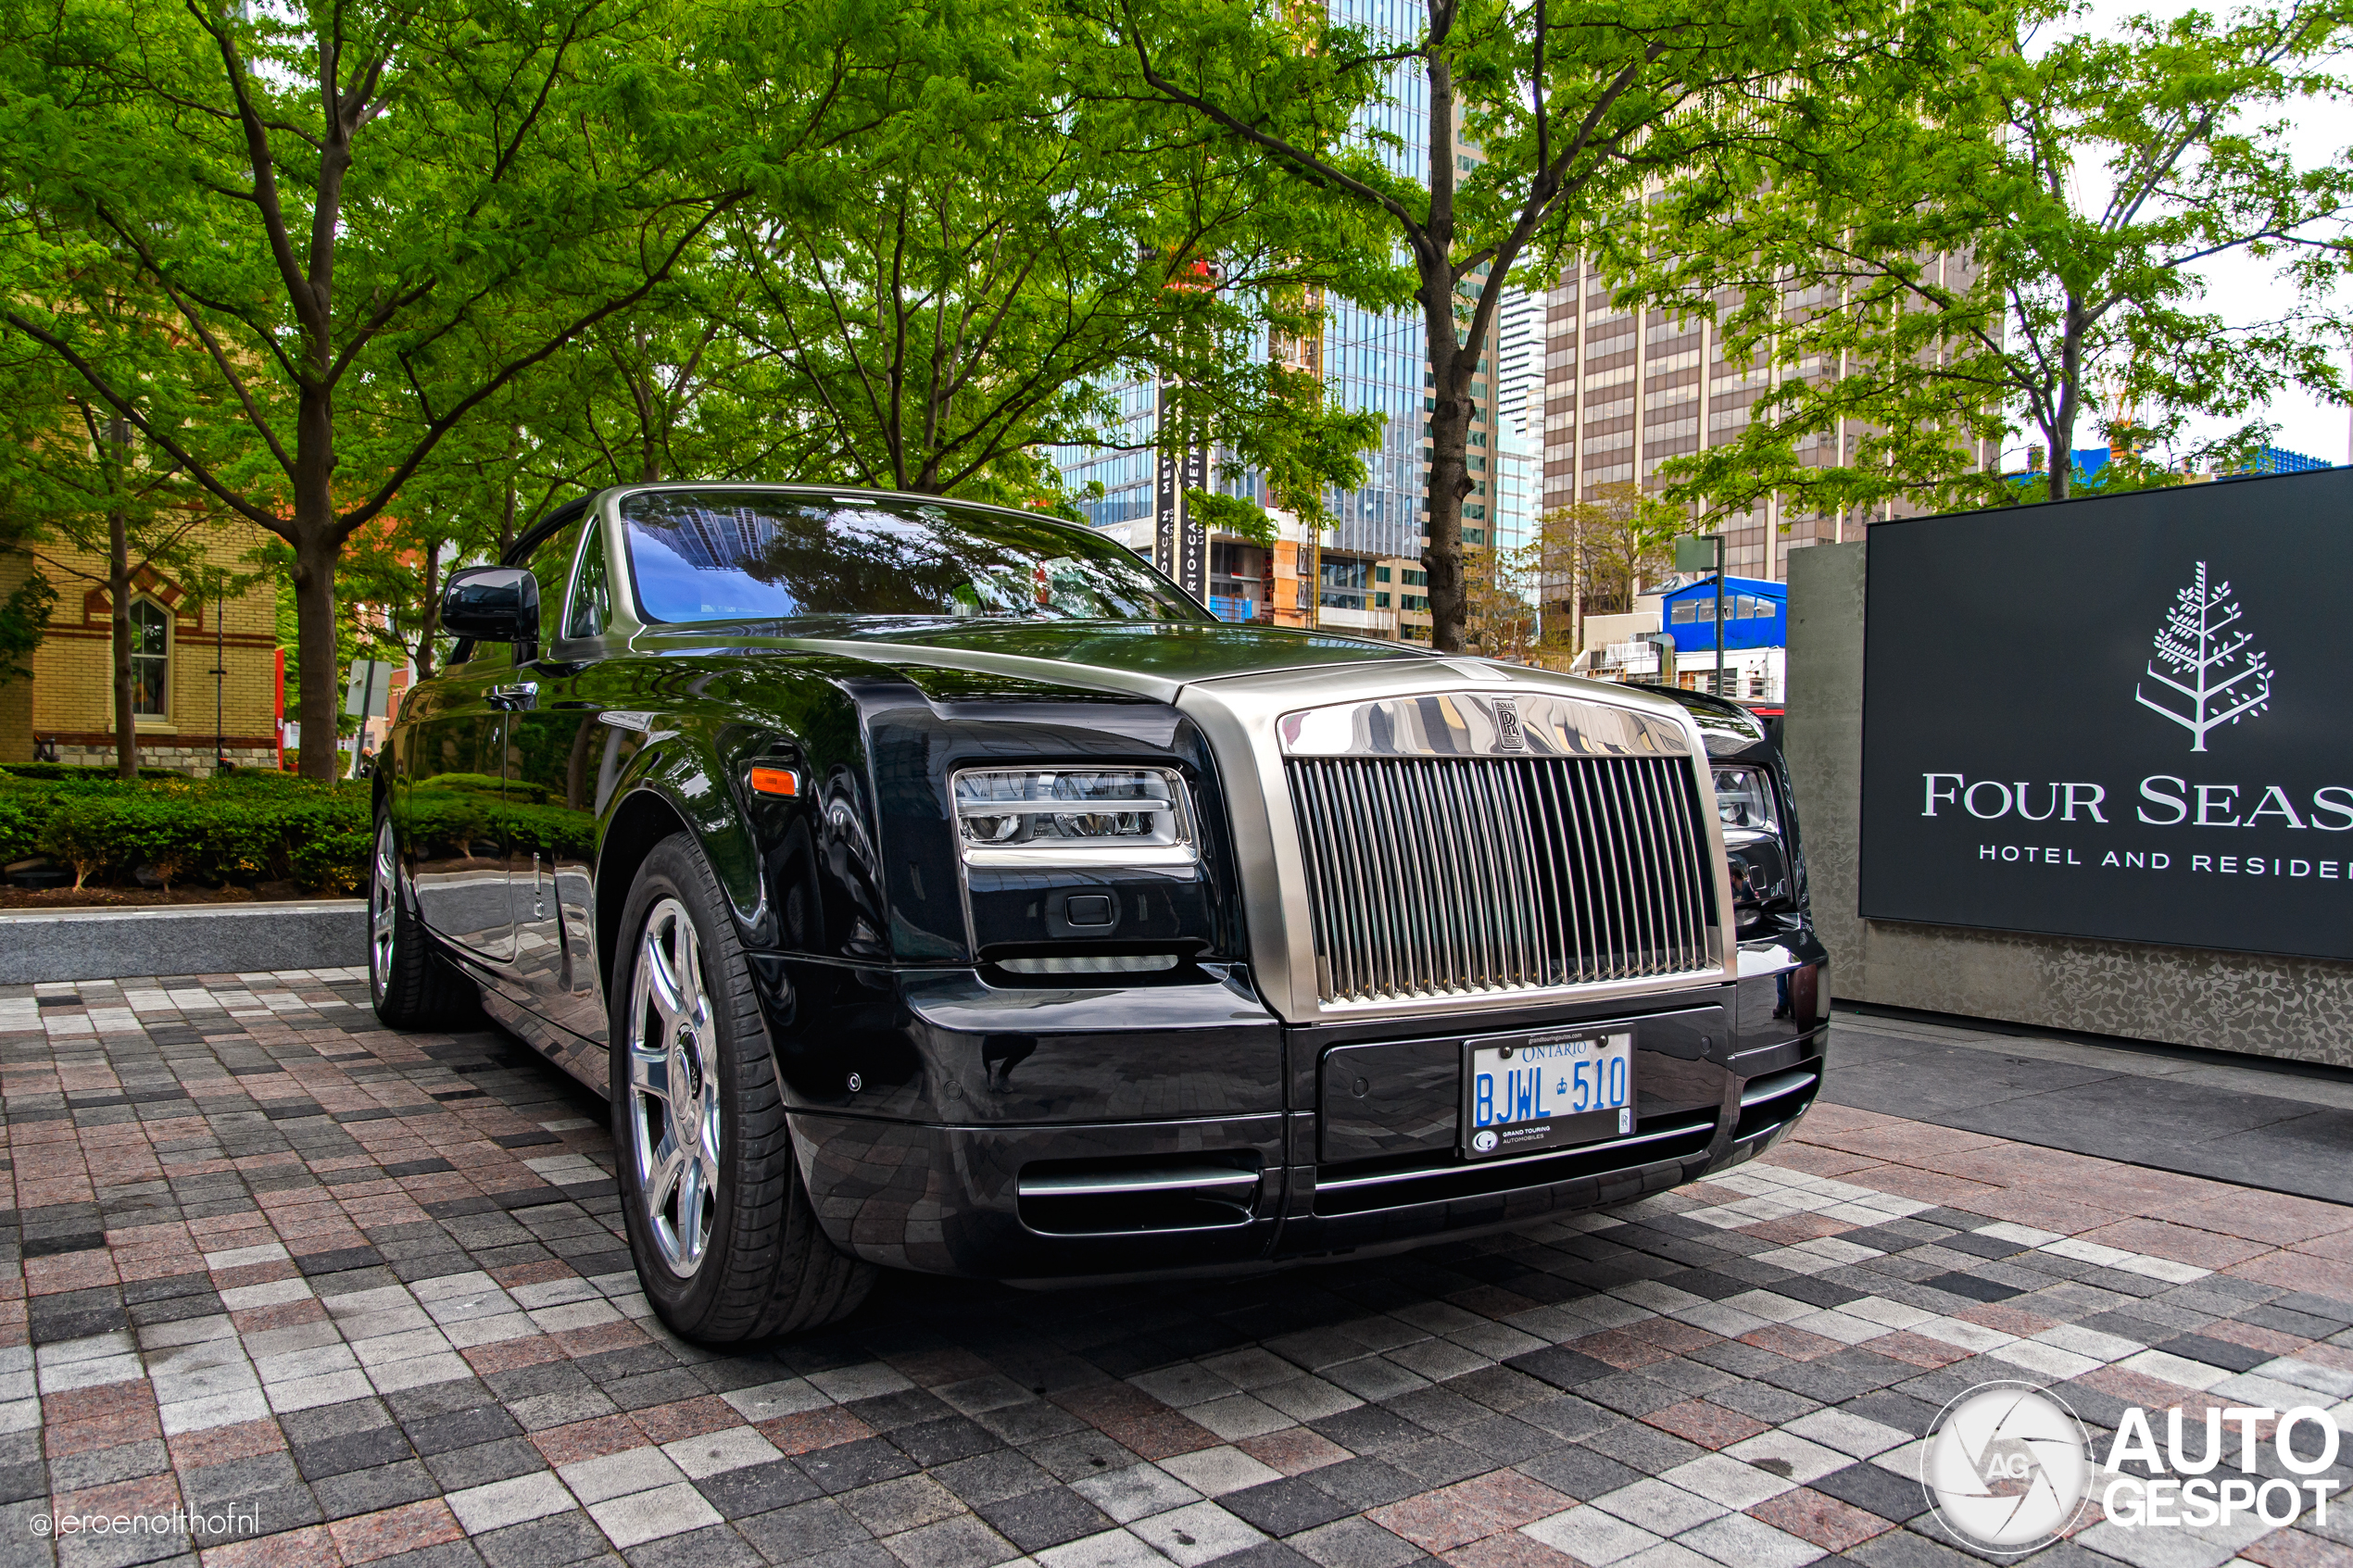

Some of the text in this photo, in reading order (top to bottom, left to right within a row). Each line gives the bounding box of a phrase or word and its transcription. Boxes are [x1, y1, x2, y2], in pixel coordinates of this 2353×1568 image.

[1921, 772, 2353, 832] FOUR SEAS
[1979, 844, 2353, 880] HOTEL AND RESIDE
[1528, 1033, 1582, 1046] grandtouringautos.com
[1522, 1041, 1587, 1063] ONTARIO
[1476, 1056, 1626, 1127] BJWL 510
[1503, 1125, 1551, 1138] GRAND TOURING
[1503, 1134, 1544, 1145] AUTOMOBILES
